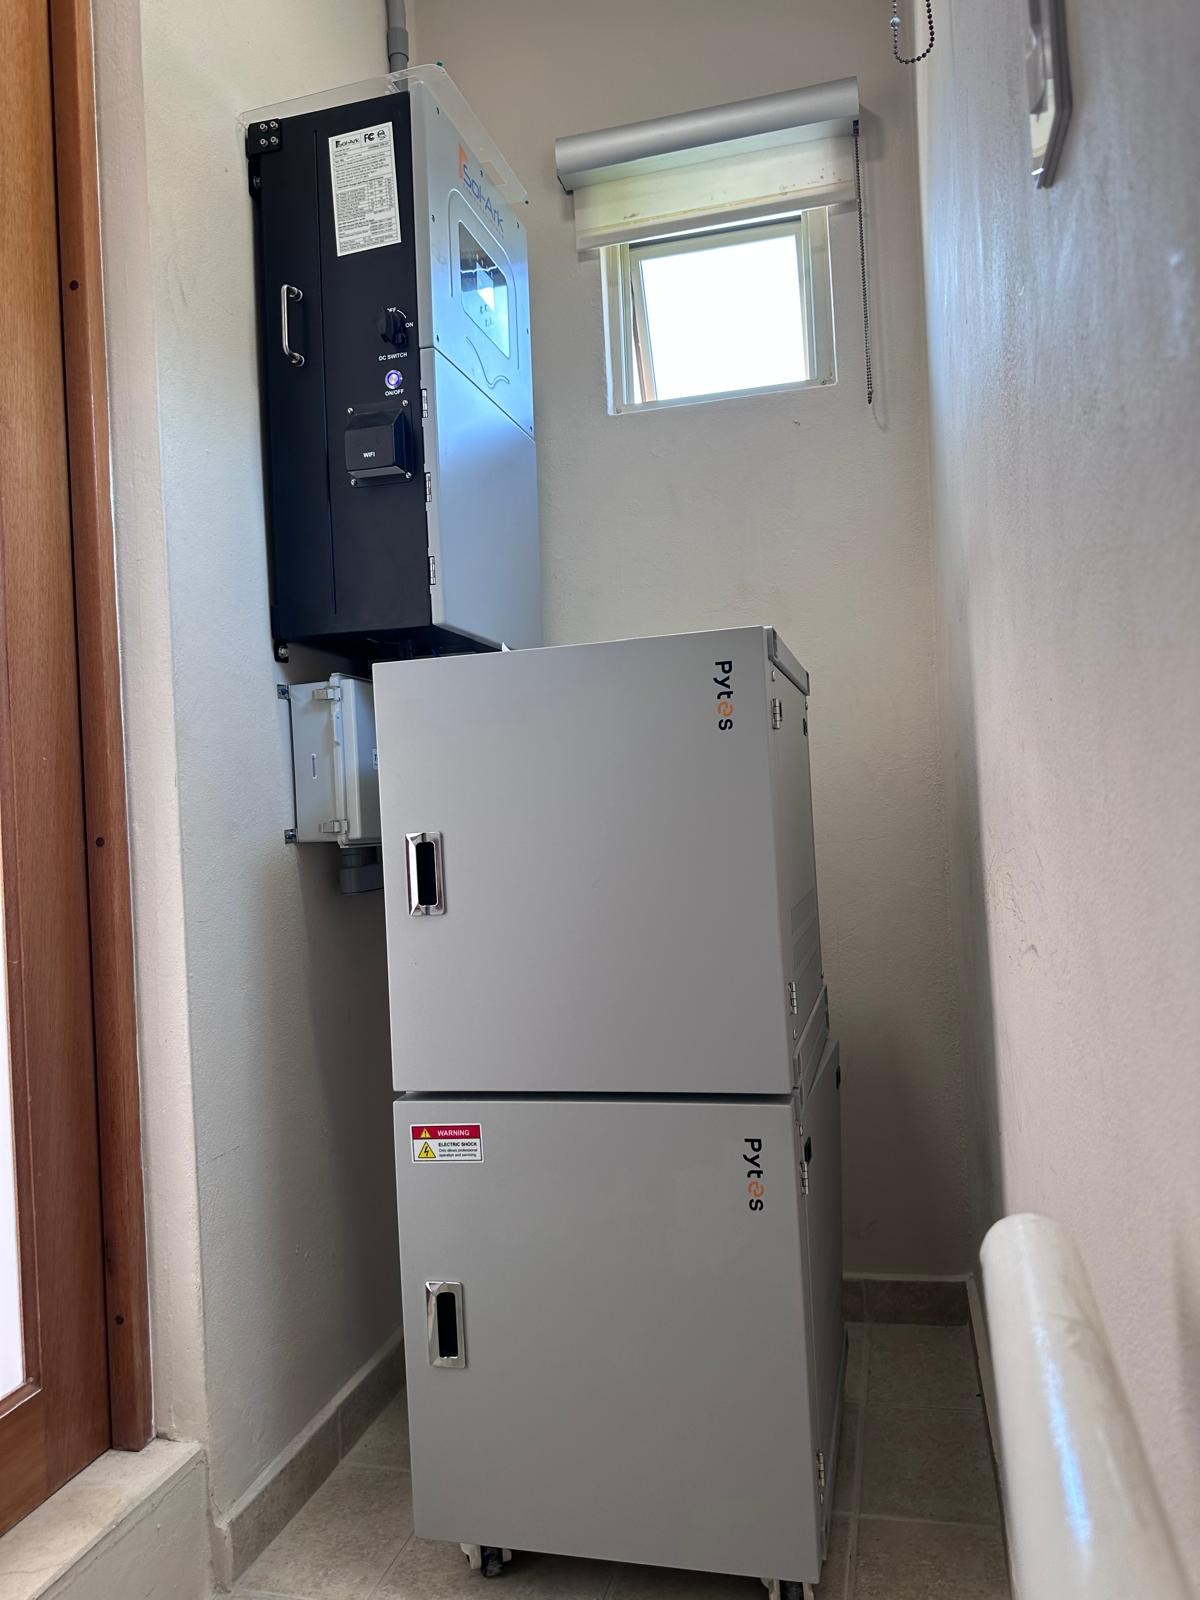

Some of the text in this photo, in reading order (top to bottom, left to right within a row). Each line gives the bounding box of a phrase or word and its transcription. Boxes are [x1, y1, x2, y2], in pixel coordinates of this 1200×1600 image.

[387, 352, 408, 360] SWITCH
[713, 660, 734, 731] Pytes
[437, 1129, 470, 1137] WARNING
[743, 1138, 764, 1211] Pytes
